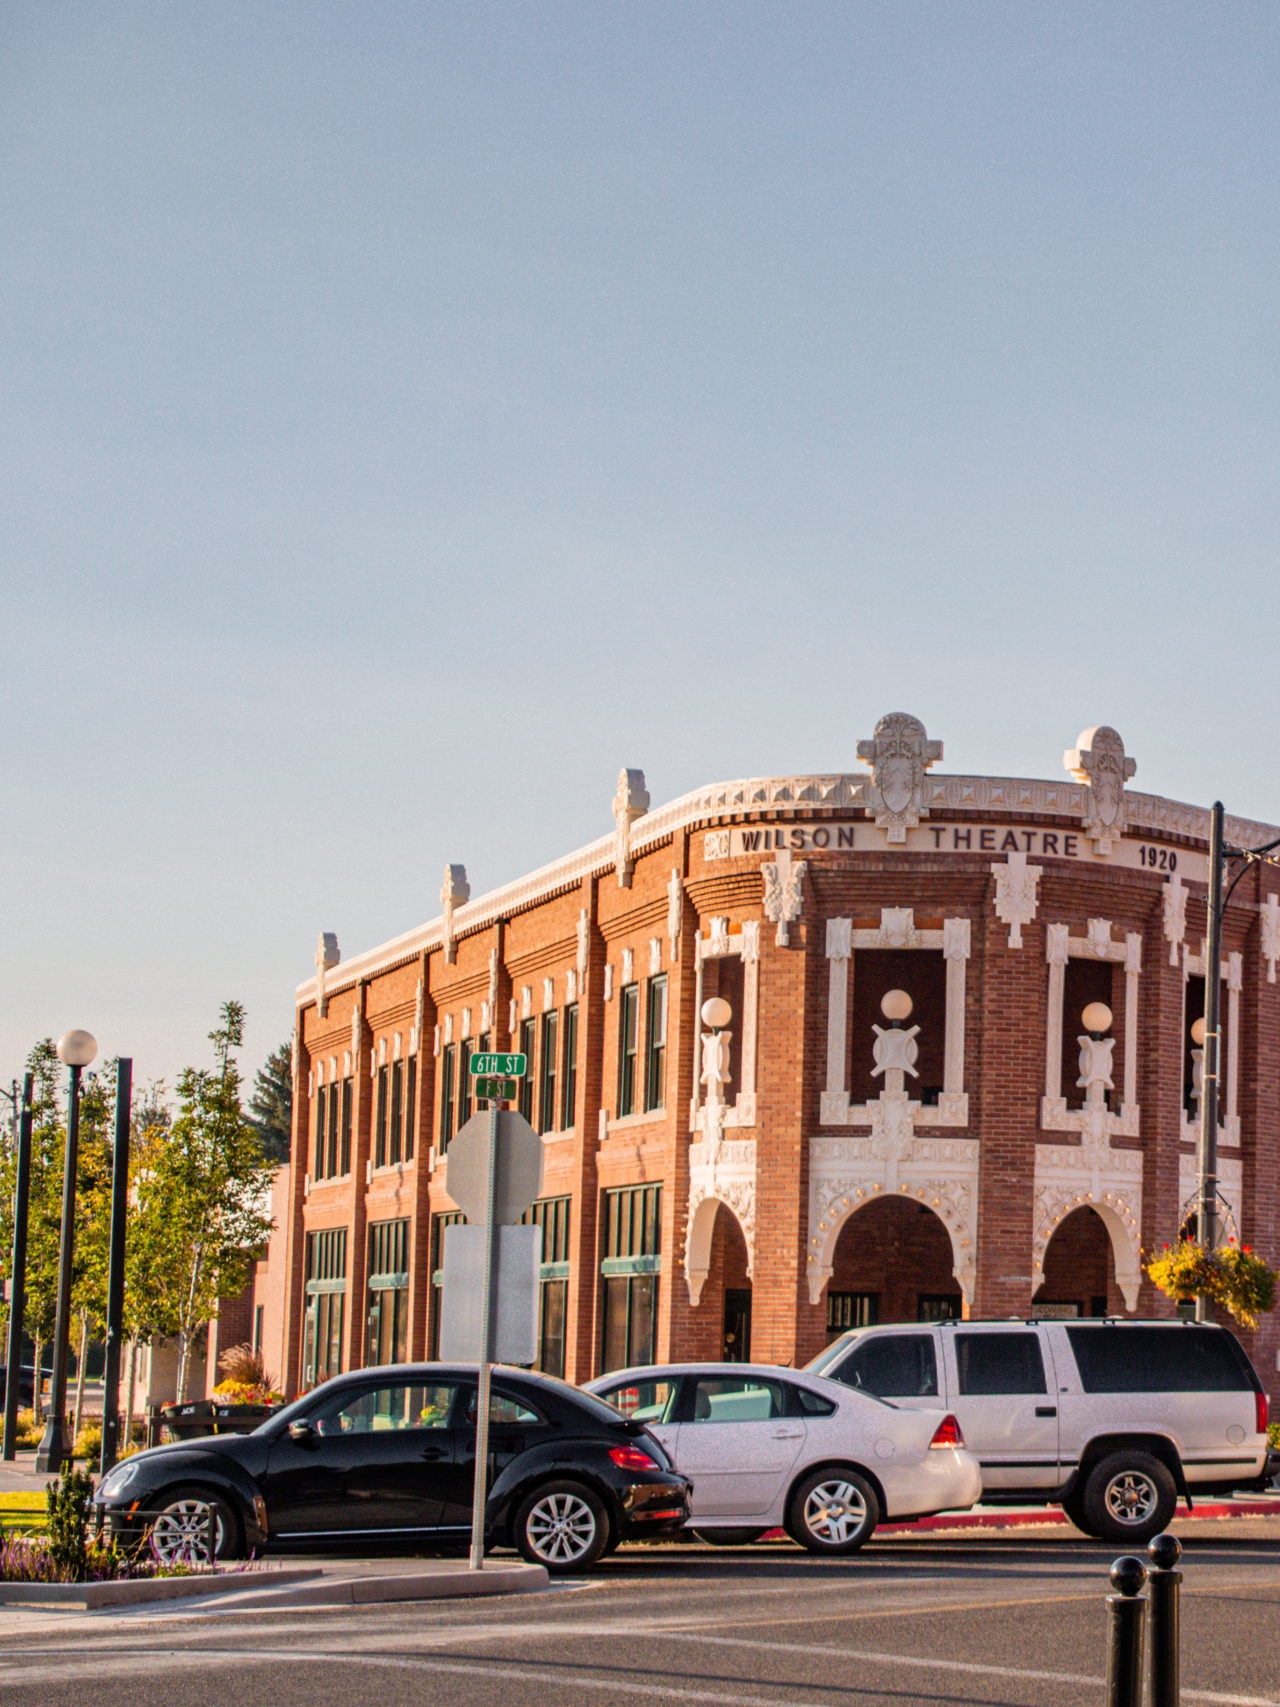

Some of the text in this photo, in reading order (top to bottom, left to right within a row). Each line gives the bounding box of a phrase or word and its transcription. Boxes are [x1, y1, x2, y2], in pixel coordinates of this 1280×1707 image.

[741, 825, 1079, 857] WILSON THEATRE
[1138, 845, 1178, 873] 1920
[477, 1056, 519, 1073] 6TH ST
[486, 1081, 506, 1097] F ST
